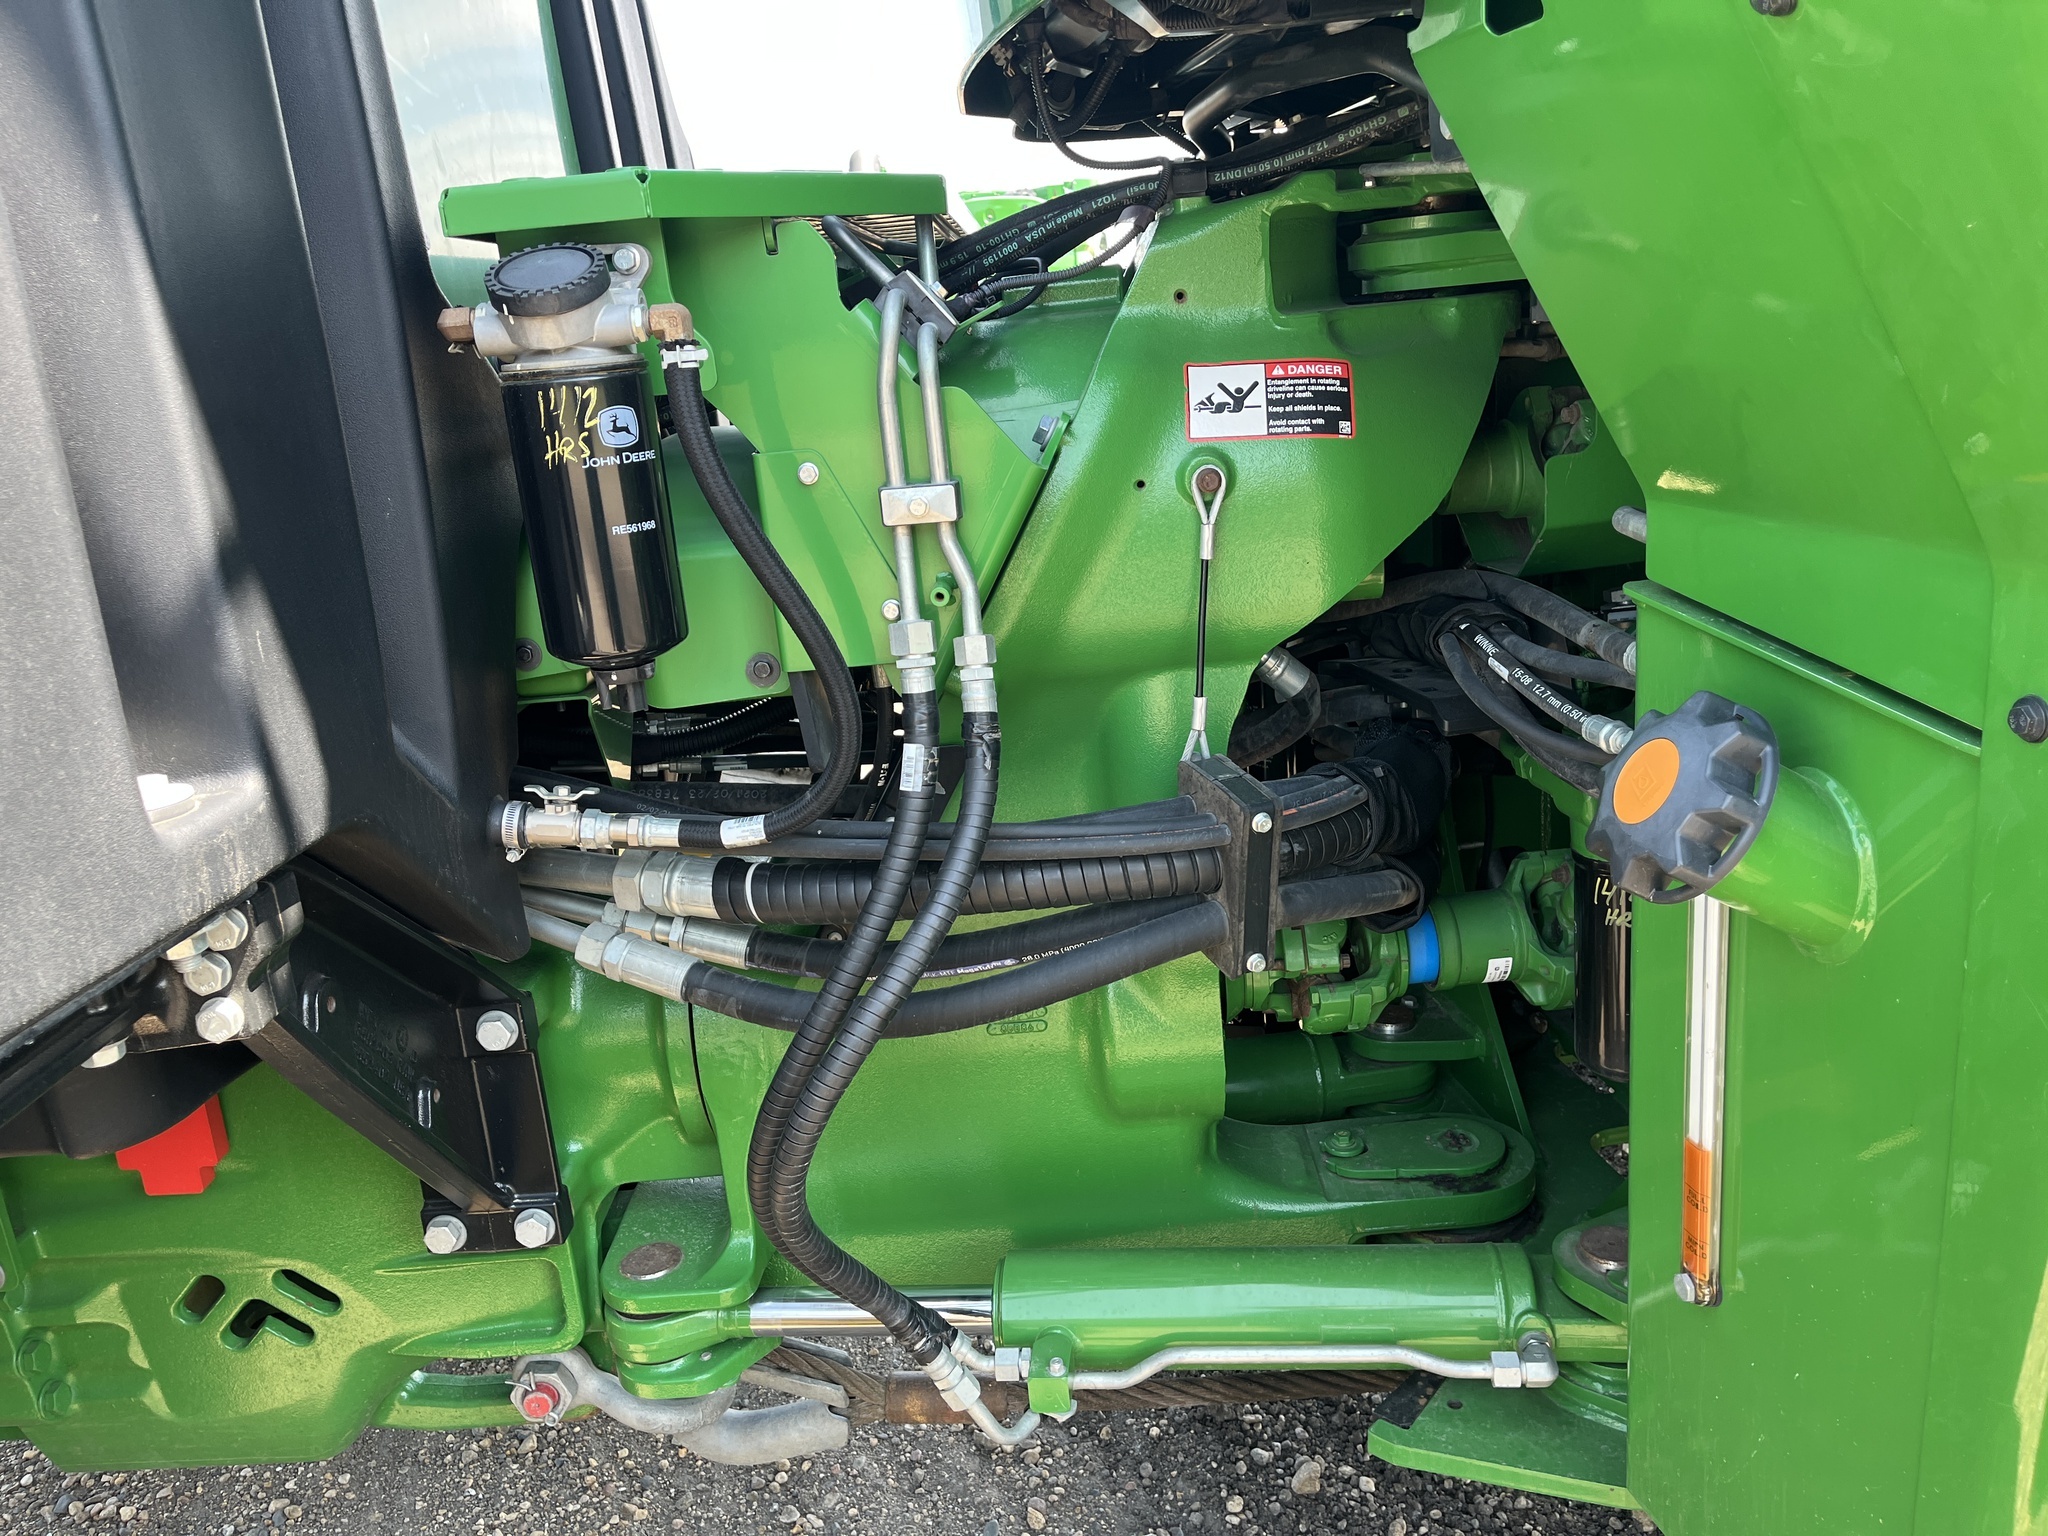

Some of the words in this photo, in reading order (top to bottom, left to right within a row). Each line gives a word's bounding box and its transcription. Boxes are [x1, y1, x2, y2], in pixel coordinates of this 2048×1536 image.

[1337, 115, 1387, 142] GH100-8
[1284, 148, 1305, 162] mm
[1307, 140, 1329, 156] 12.7
[1244, 163, 1258, 177] in)
[1258, 156, 1284, 173] (0.50
[1214, 168, 1242, 182] DN12
[1126, 181, 1147, 197] psi)
[1091, 193, 1117, 209] 1Q21
[1055, 206, 1084, 226] Made
[1046, 220, 1056, 231] in
[975, 228, 1020, 253] GH100-10
[1024, 226, 1046, 243] USA
[949, 251, 969, 265] 15.9
[982, 241, 1019, 267] 0001195
[1288, 364, 1343, 375] DANGER
[1317, 378, 1340, 386] rotating
[545, 430, 591, 470] HRS
[582, 455, 621, 469] JOHN
[622, 450, 656, 464] DEERE
[612, 520, 656, 536] RE561968
[1511, 667, 1533, 686] 15-08
[1532, 684, 1552, 699] 12.7
[1547, 695, 1562, 709] mm
[1560, 703, 1584, 720] (0.50
[1594, 877, 1632, 906] 141
[1041, 949, 1060, 960] MPa
